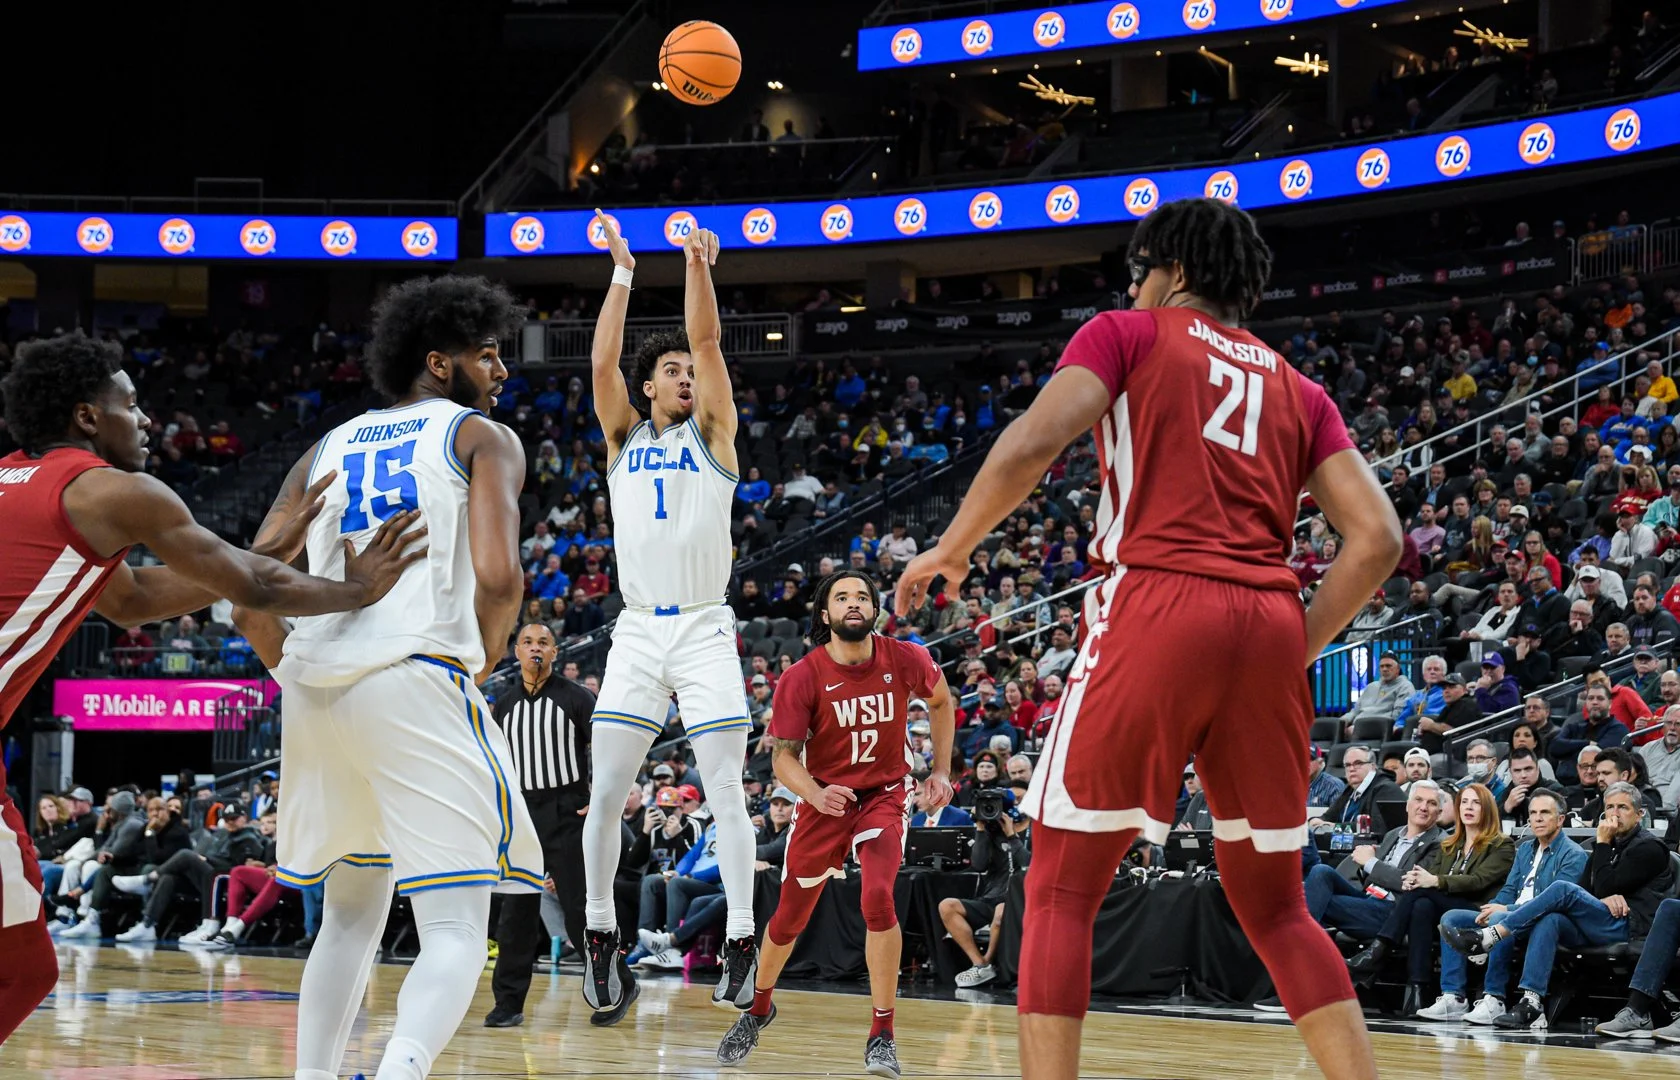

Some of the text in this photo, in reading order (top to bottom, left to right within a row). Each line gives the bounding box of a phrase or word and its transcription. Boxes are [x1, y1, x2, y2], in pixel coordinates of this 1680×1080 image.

[1114, 9, 1134, 29] 76
[1190, 1, 1210, 21] 76
[969, 27, 988, 45] 76
[1040, 19, 1060, 38] 76
[898, 36, 916, 53] 76
[1613, 115, 1635, 140] 76
[1526, 129, 1549, 153] 76
[1443, 142, 1465, 166] 76
[1363, 155, 1385, 178] 76
[1287, 166, 1307, 189] 76
[1132, 185, 1153, 206] 76
[1212, 179, 1233, 199] 76
[976, 198, 997, 219] 76
[1053, 192, 1074, 213] 76
[750, 215, 770, 235] 76
[828, 211, 847, 231] 76
[902, 205, 921, 225] 76
[4, 224, 24, 242] 76
[87, 226, 106, 243] 76
[169, 227, 188, 245] 76
[250, 228, 269, 246] 76
[330, 228, 350, 247] 76
[412, 229, 431, 247] 76
[520, 224, 538, 243] 76
[671, 220, 692, 237] 76
[936, 314, 969, 330] zayo
[997, 310, 1032, 327] zayo
[1062, 305, 1097, 323] zayo
[815, 320, 849, 336] zayo
[875, 317, 909, 333] zayo
[1187, 318, 1277, 374] JACKSON
[1202, 353, 1264, 456] 21
[347, 417, 430, 444] JOHNSON
[628, 446, 700, 474] UCLA
[340, 439, 419, 534] 15
[654, 478, 668, 520] 1
[102, 693, 167, 717] Mobile
[831, 692, 895, 728] WSU
[850, 729, 879, 766] 12
